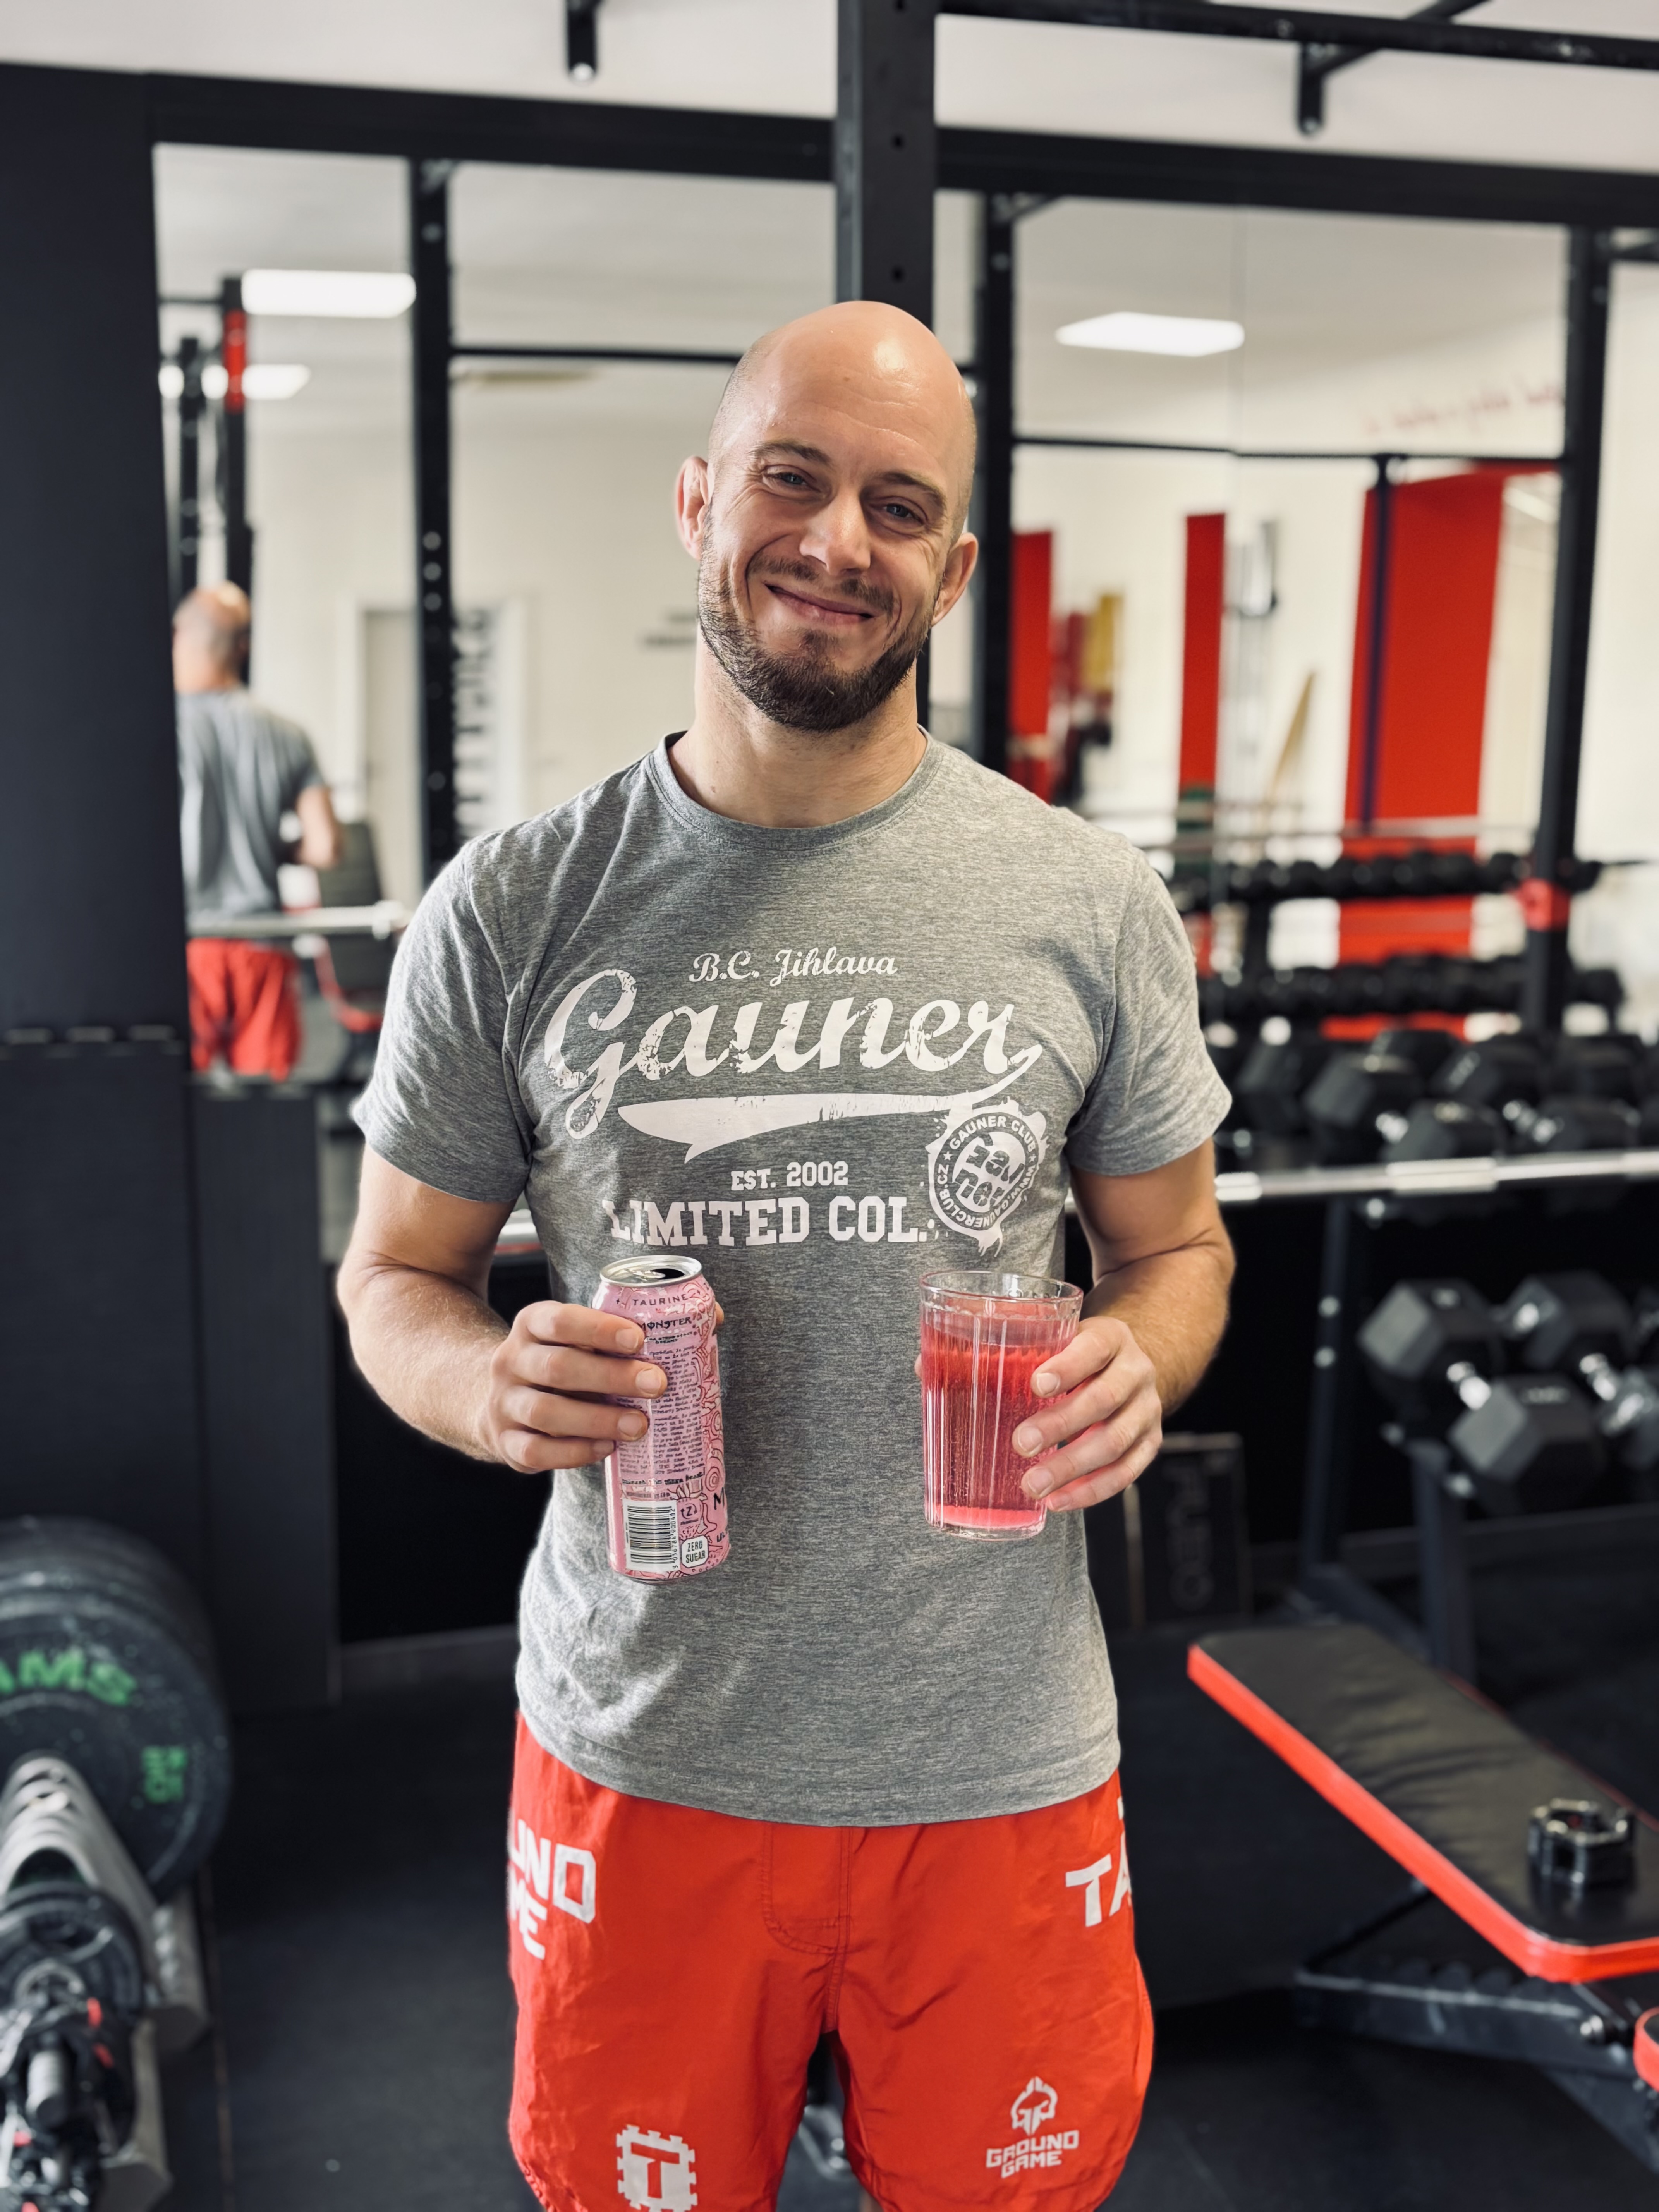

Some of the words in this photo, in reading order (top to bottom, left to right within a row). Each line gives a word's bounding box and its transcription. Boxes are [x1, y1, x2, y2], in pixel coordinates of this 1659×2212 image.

[689, 951, 759, 983] B.C.
[769, 947, 898, 986] Jihlava
[544, 969, 1042, 1139] Gauner
[950, 1116, 1006, 1150] GAUNER
[1011, 1120, 1036, 1152] CLUB
[731, 1168, 776, 1191] EST.
[786, 1161, 849, 1187] 2002
[602, 1197, 810, 1247] LIMITED
[828, 1196, 927, 1243] COL.
[632, 1293, 688, 1306] TAURINE
[687, 1540, 703, 1552] ZERO
[986, 2130, 1079, 2168] GROUND
[1001, 2150, 1062, 2178] GAME
